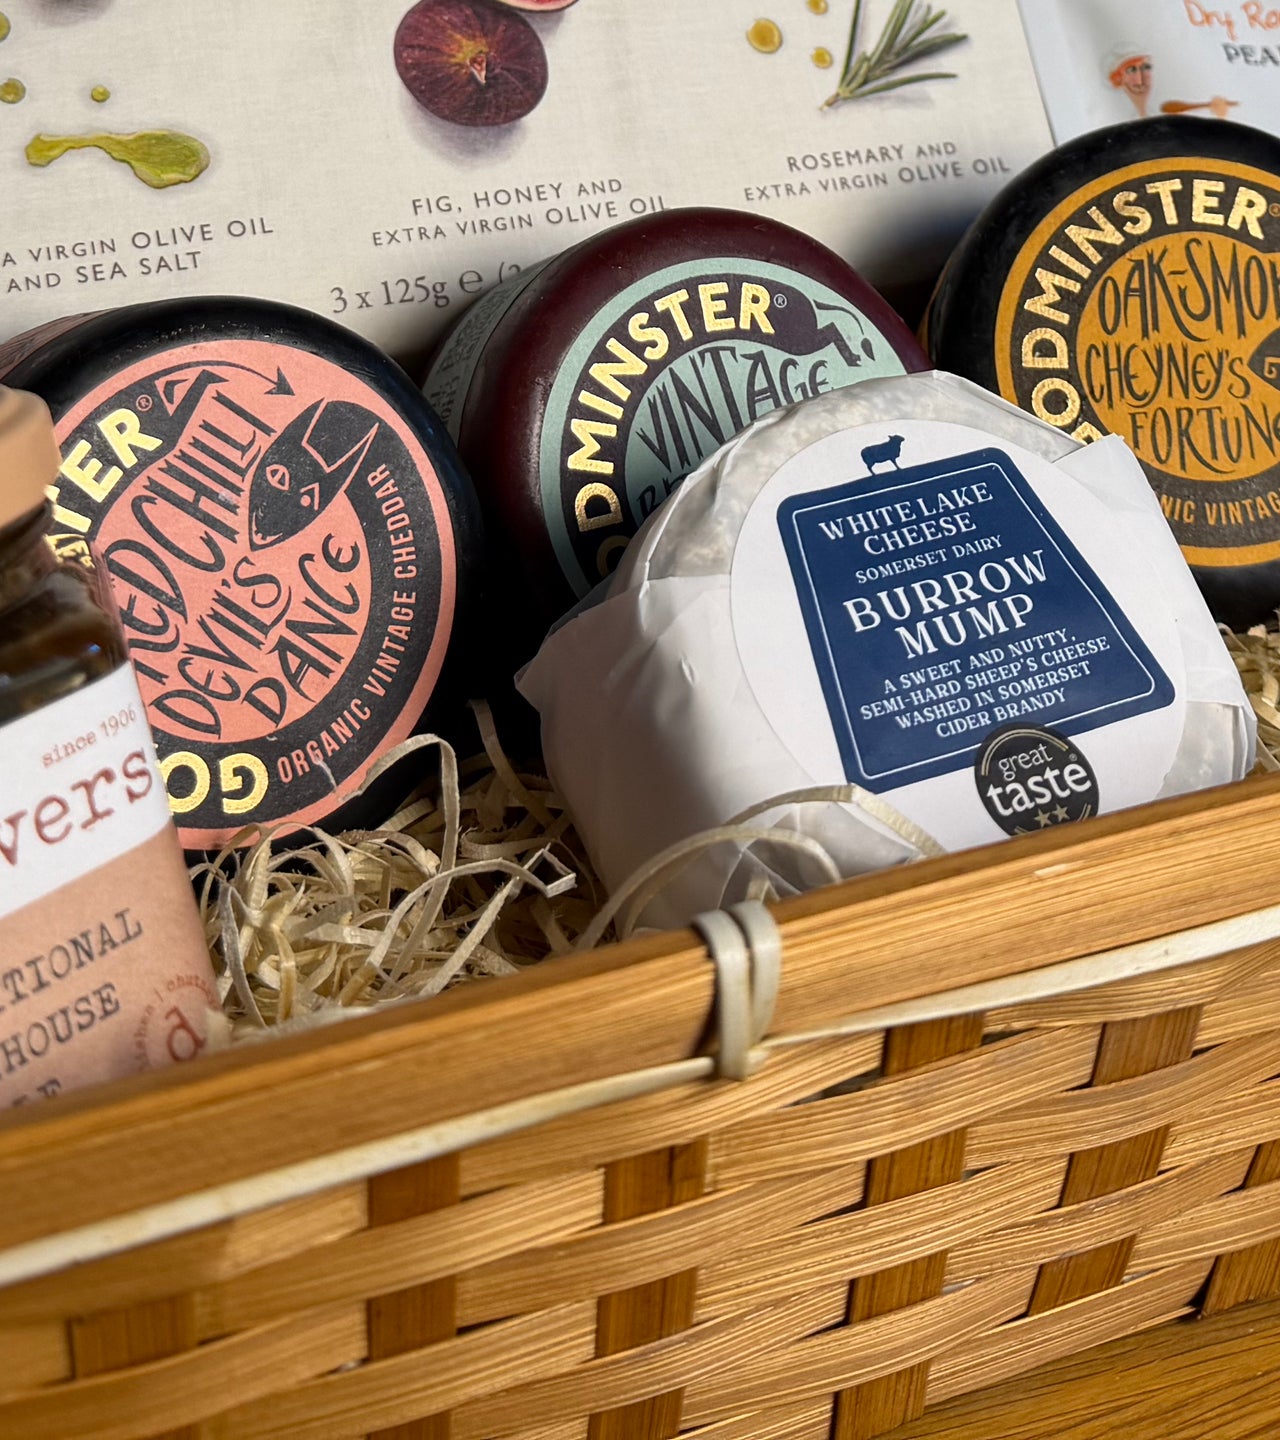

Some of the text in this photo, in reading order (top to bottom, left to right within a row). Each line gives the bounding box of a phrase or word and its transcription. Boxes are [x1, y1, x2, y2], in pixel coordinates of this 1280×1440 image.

[744, 157, 1011, 202] EXTRA VIRGIN OLIVE OIL
[786, 141, 957, 173] ROSEMARY AND
[372, 195, 668, 247] EXTRA VIRGIN OLIVE OIL
[411, 178, 622, 217] FIG, HONEY AND
[28, 238, 116, 263] VIRGIN
[131, 223, 214, 250] OLIVE
[227, 217, 274, 238] OIL
[6, 250, 202, 293] AND SEA SALT
[330, 286, 348, 314] 3
[355, 290, 373, 310] x
[381, 275, 450, 309] 125g
[1085, 340, 1252, 408] CHEYNEY'S
[567, 281, 776, 578] ODMINSTER
[129, 389, 278, 573] CHILLI
[818, 482, 994, 540] WHITE LAKE
[863, 511, 977, 555] CHEESE
[855, 534, 1004, 584] SOMERSET DAIRY
[842, 549, 1047, 633] BURROW
[150, 555, 292, 740] DEVIL'S
[242, 532, 361, 728] DANCE
[277, 463, 418, 784] ORGANIC VINTAGE CHEDDAR
[893, 593, 1034, 660] MUMP
[859, 635, 1111, 721] SEMI-HARD SHEEP'S CHEESE
[883, 627, 1077, 694] A SWEET AND NUTTY,
[895, 659, 1091, 730] WASHED IN SOMERSET
[935, 687, 1067, 738] CIDER BRANDY
[41, 704, 138, 767] since 1906
[998, 743, 1053, 781] great
[986, 763, 1093, 816] taste
